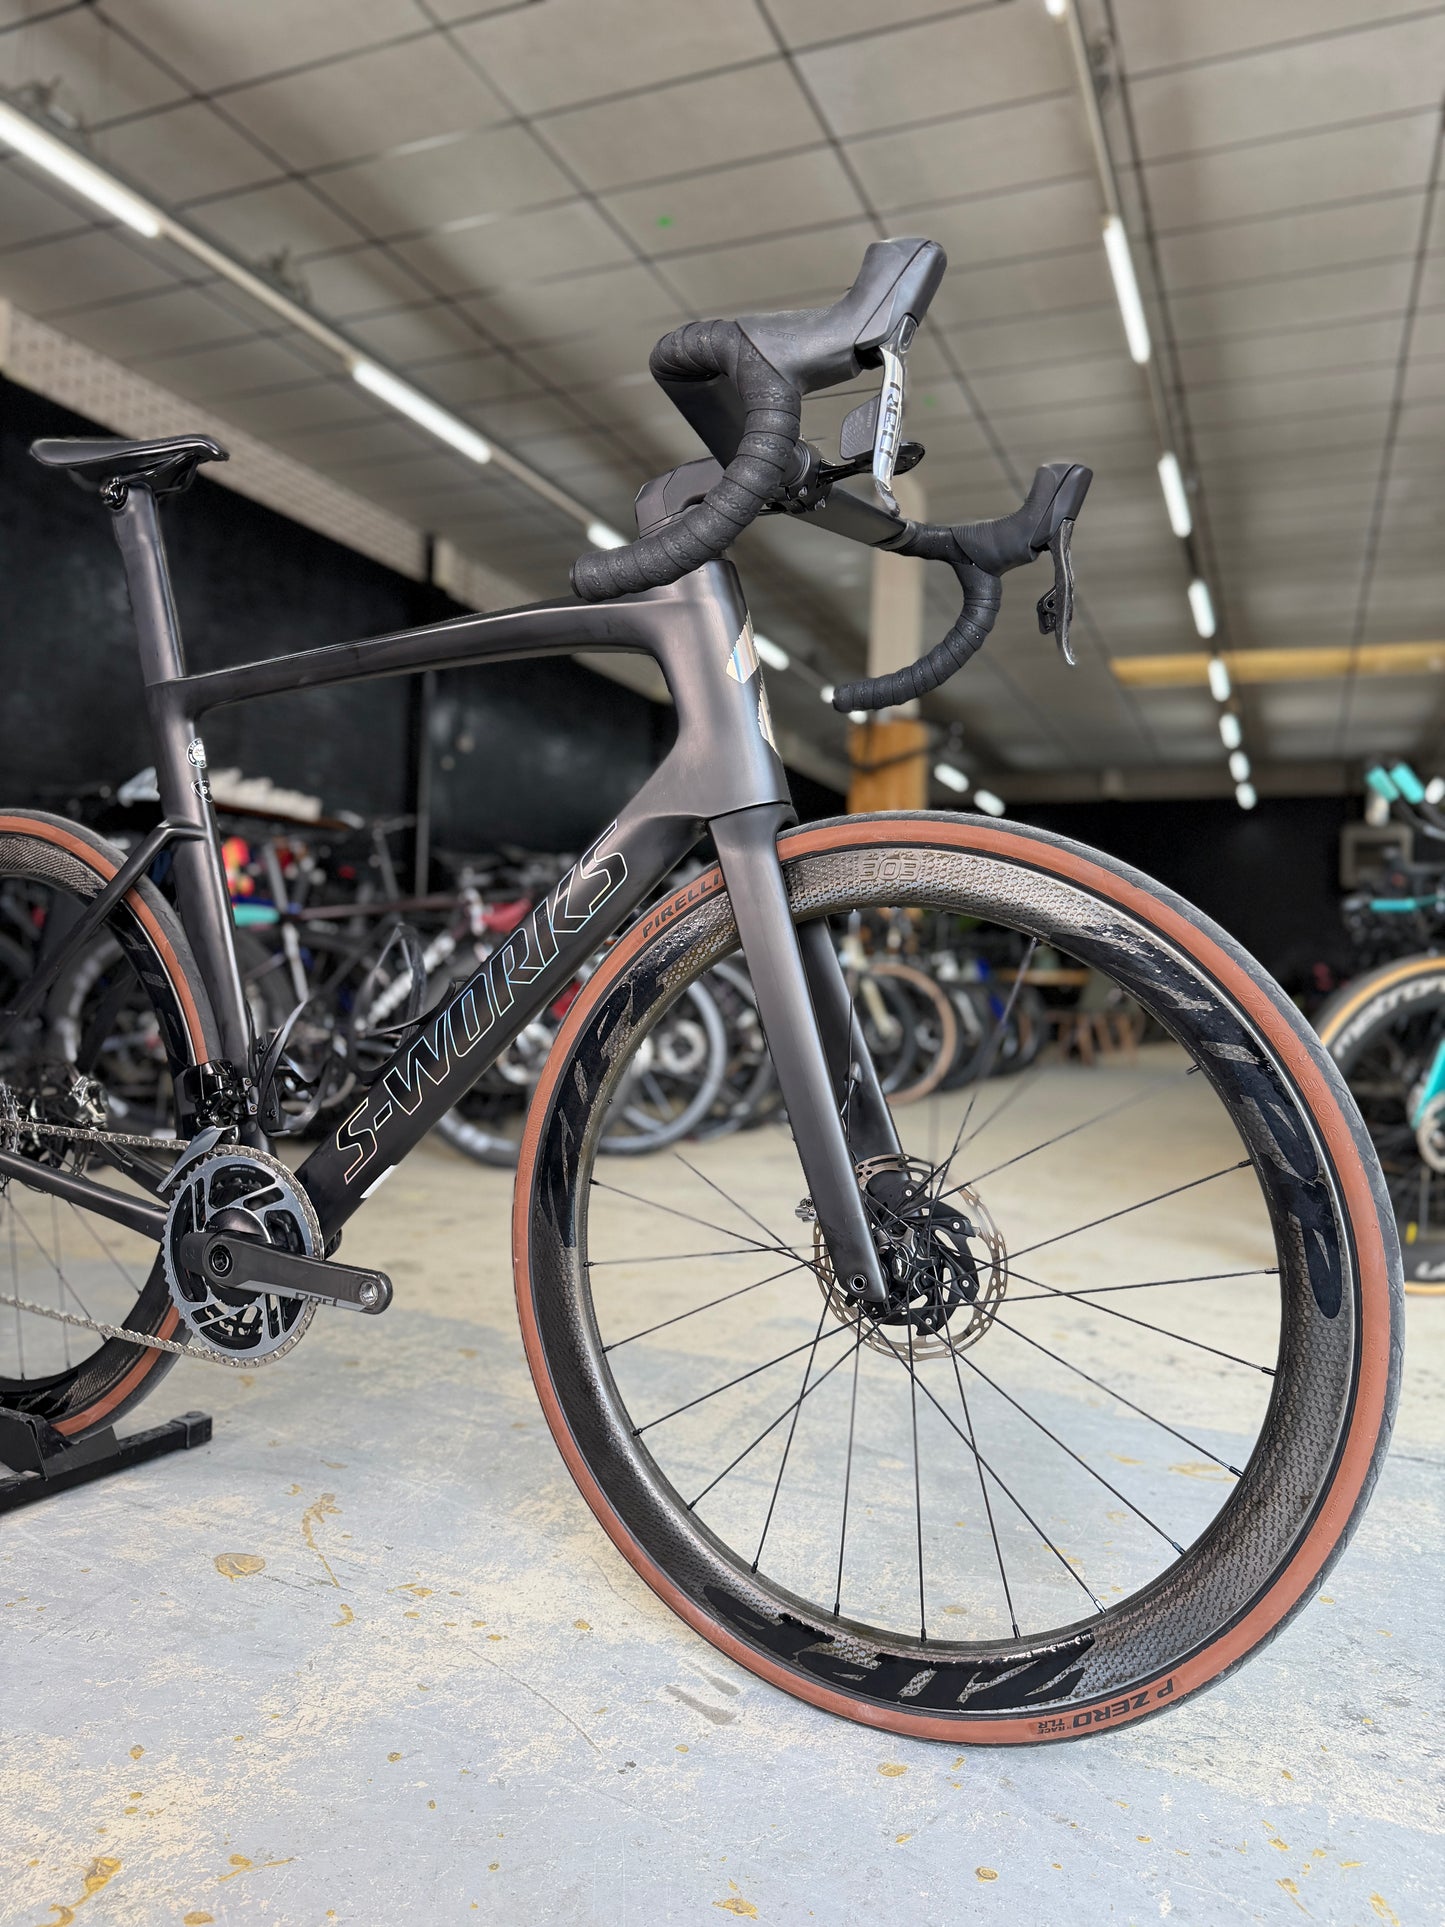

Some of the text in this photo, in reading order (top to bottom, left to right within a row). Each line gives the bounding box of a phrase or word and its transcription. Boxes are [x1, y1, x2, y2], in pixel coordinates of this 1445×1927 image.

[860, 858, 920, 881] 303
[642, 873, 720, 939] PIRELLI
[336, 819, 628, 1185] S-WORKS
[1073, 1678, 1174, 1728] P ZERO
[1037, 1725, 1065, 1734] RACE
[1038, 1718, 1064, 1729] TLR
